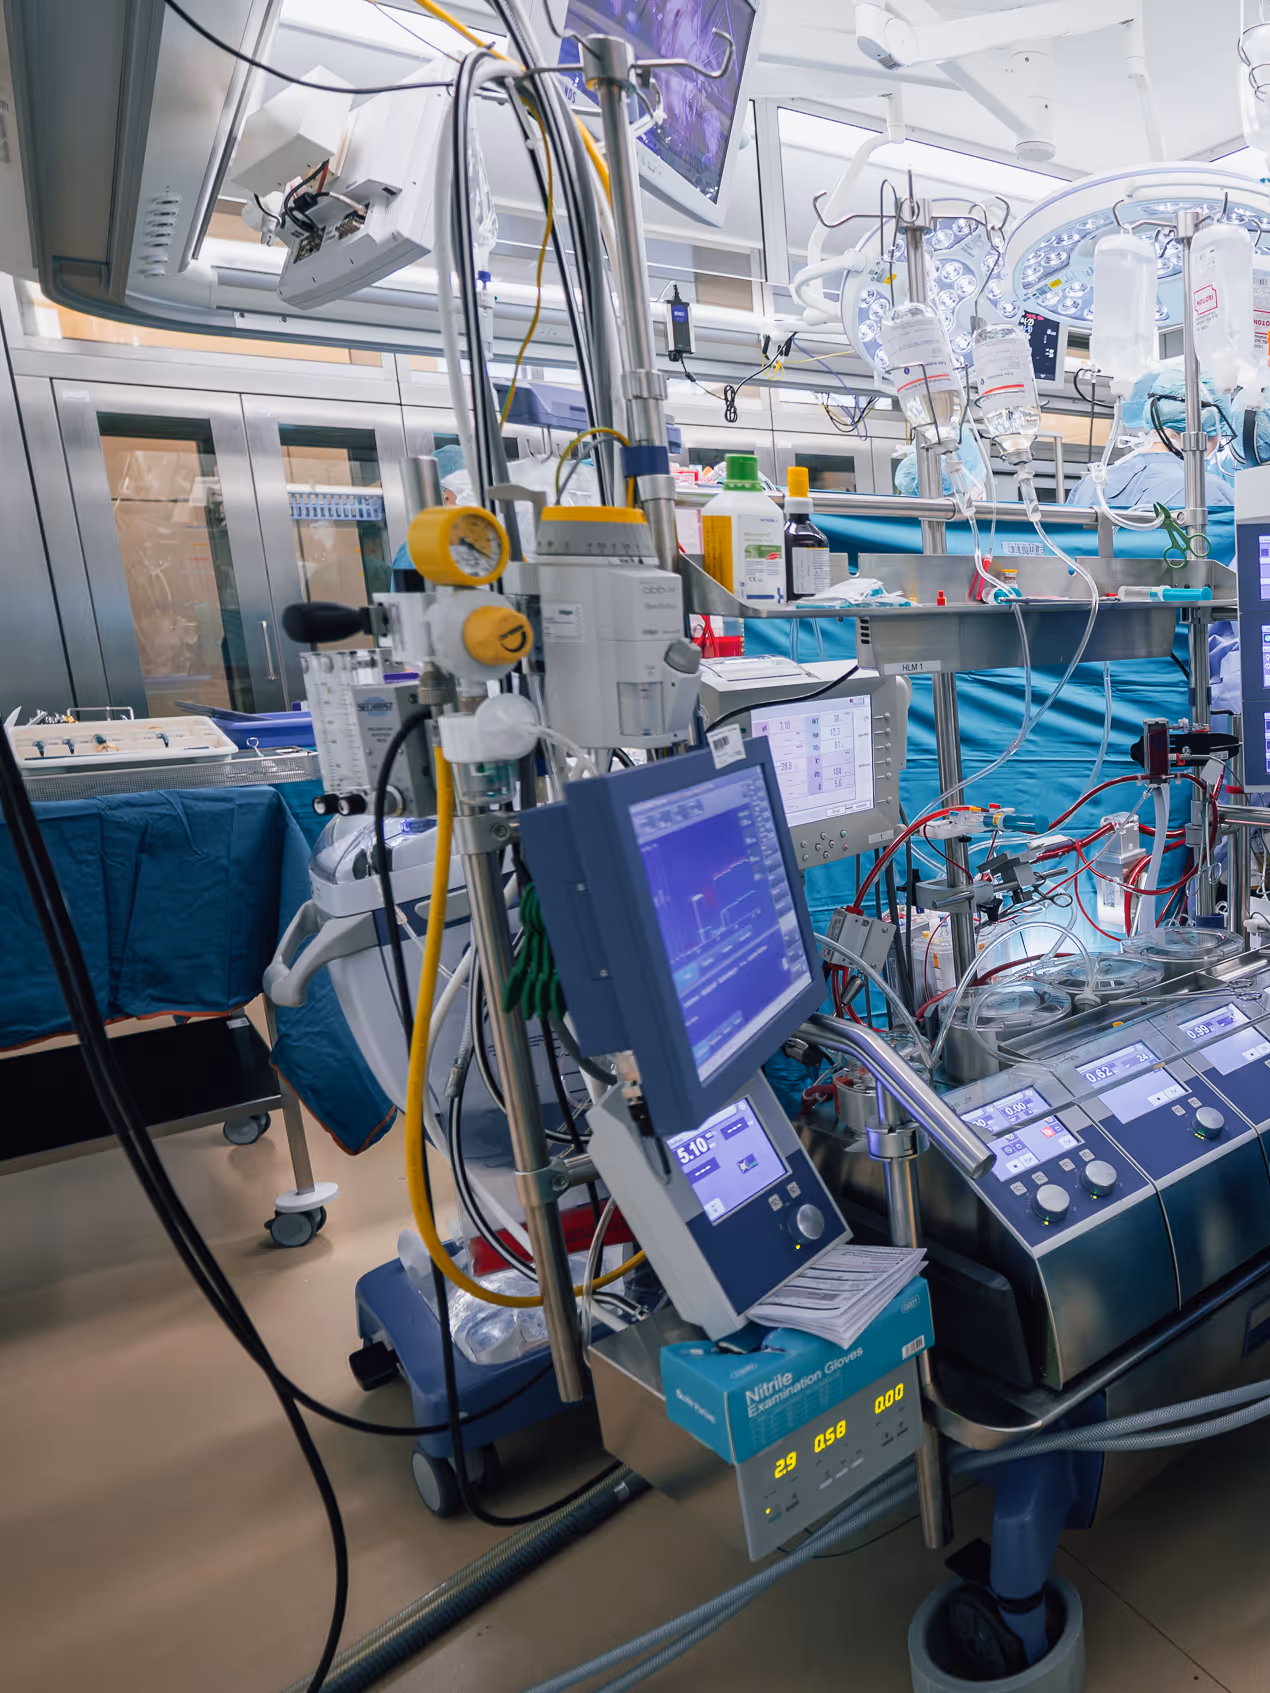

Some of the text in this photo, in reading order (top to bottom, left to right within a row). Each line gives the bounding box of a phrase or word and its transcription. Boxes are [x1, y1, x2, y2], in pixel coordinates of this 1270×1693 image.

[902, 664, 918, 672] HLM
[1186, 1024, 1210, 1039] 0.99
[1085, 1053, 1149, 1083] 0.62 24
[1005, 1101, 1027, 1116] 0.00
[676, 1137, 709, 1164] 5.10
[745, 1370, 794, 1402] Nitrile
[748, 1369, 823, 1418] Examination
[824, 1346, 865, 1375] Gloves
